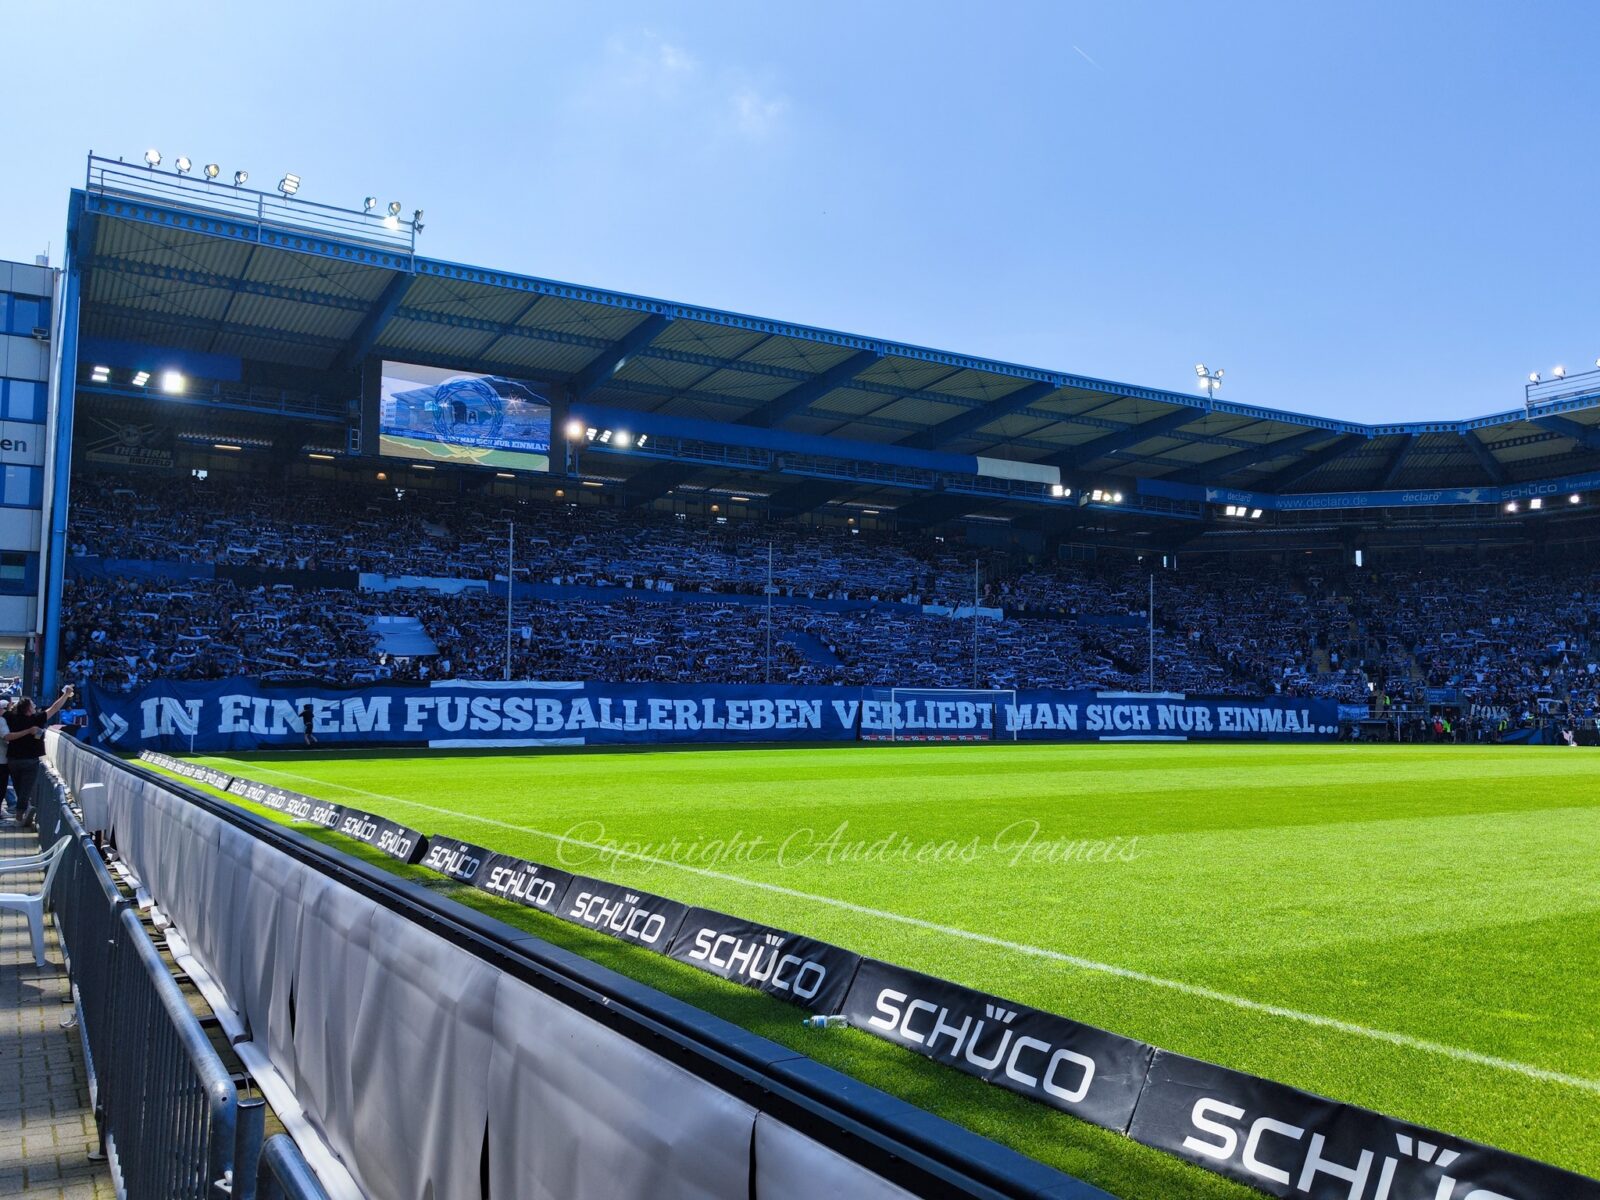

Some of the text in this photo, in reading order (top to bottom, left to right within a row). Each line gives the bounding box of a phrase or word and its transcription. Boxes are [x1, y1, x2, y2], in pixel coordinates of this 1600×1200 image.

[1276, 495, 1367, 509] www.declaro.de
[1403, 491, 1440, 502] declaro
[1501, 483, 1557, 499] SCHÜCO
[140, 697, 203, 738] IN
[218, 694, 392, 735] EINEM
[404, 696, 823, 732] FUSSBALLERLEBEN
[832, 700, 994, 730] VERLIEBT
[1004, 703, 1080, 732] MAN
[1086, 704, 1151, 731] SICH
[1157, 704, 1214, 732] NUR
[341, 815, 378, 840] SCHÜCO
[377, 828, 412, 858] SCHÜCO
[426, 846, 480, 879] SCHÜCO
[486, 866, 556, 906] SCHÜCO
[570, 893, 666, 943] SCHÜCO
[689, 928, 826, 999] SCHÜCO
[868, 988, 1095, 1103] SCHÜCO
